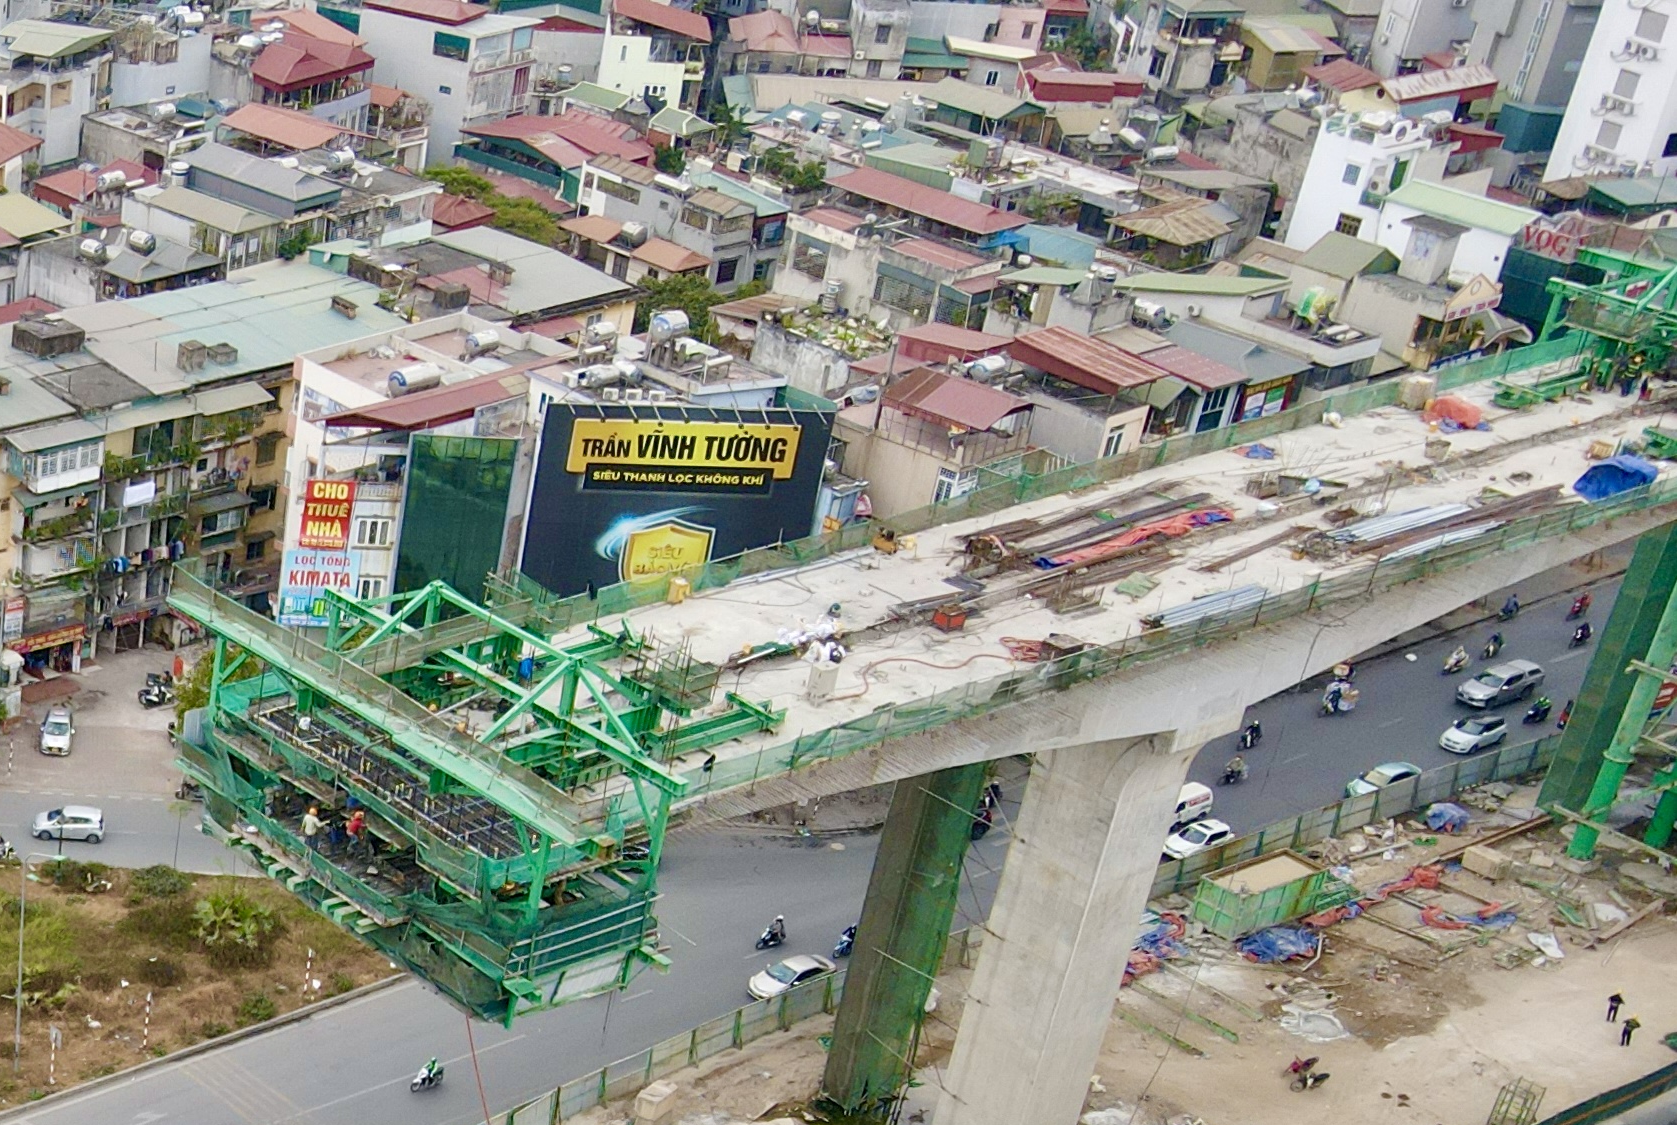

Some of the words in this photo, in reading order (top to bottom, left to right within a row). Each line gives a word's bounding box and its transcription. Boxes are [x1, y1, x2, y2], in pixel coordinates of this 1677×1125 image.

[581, 432, 631, 458] TRẦN
[636, 428, 696, 460] VĨNH
[704, 430, 788, 463] TƯỜNG
[592, 468, 620, 481] SIÊU
[623, 471, 665, 483] THANH
[668, 473, 693, 484] LỌC
[695, 473, 740, 485] KHÔNG
[742, 474, 765, 486] KHÍ
[313, 482, 349, 500] CHO
[306, 502, 350, 518] THUÊ
[305, 519, 342, 538] NHÀ
[647, 543, 685, 560] SIÊU
[288, 569, 351, 588] KIMATA
